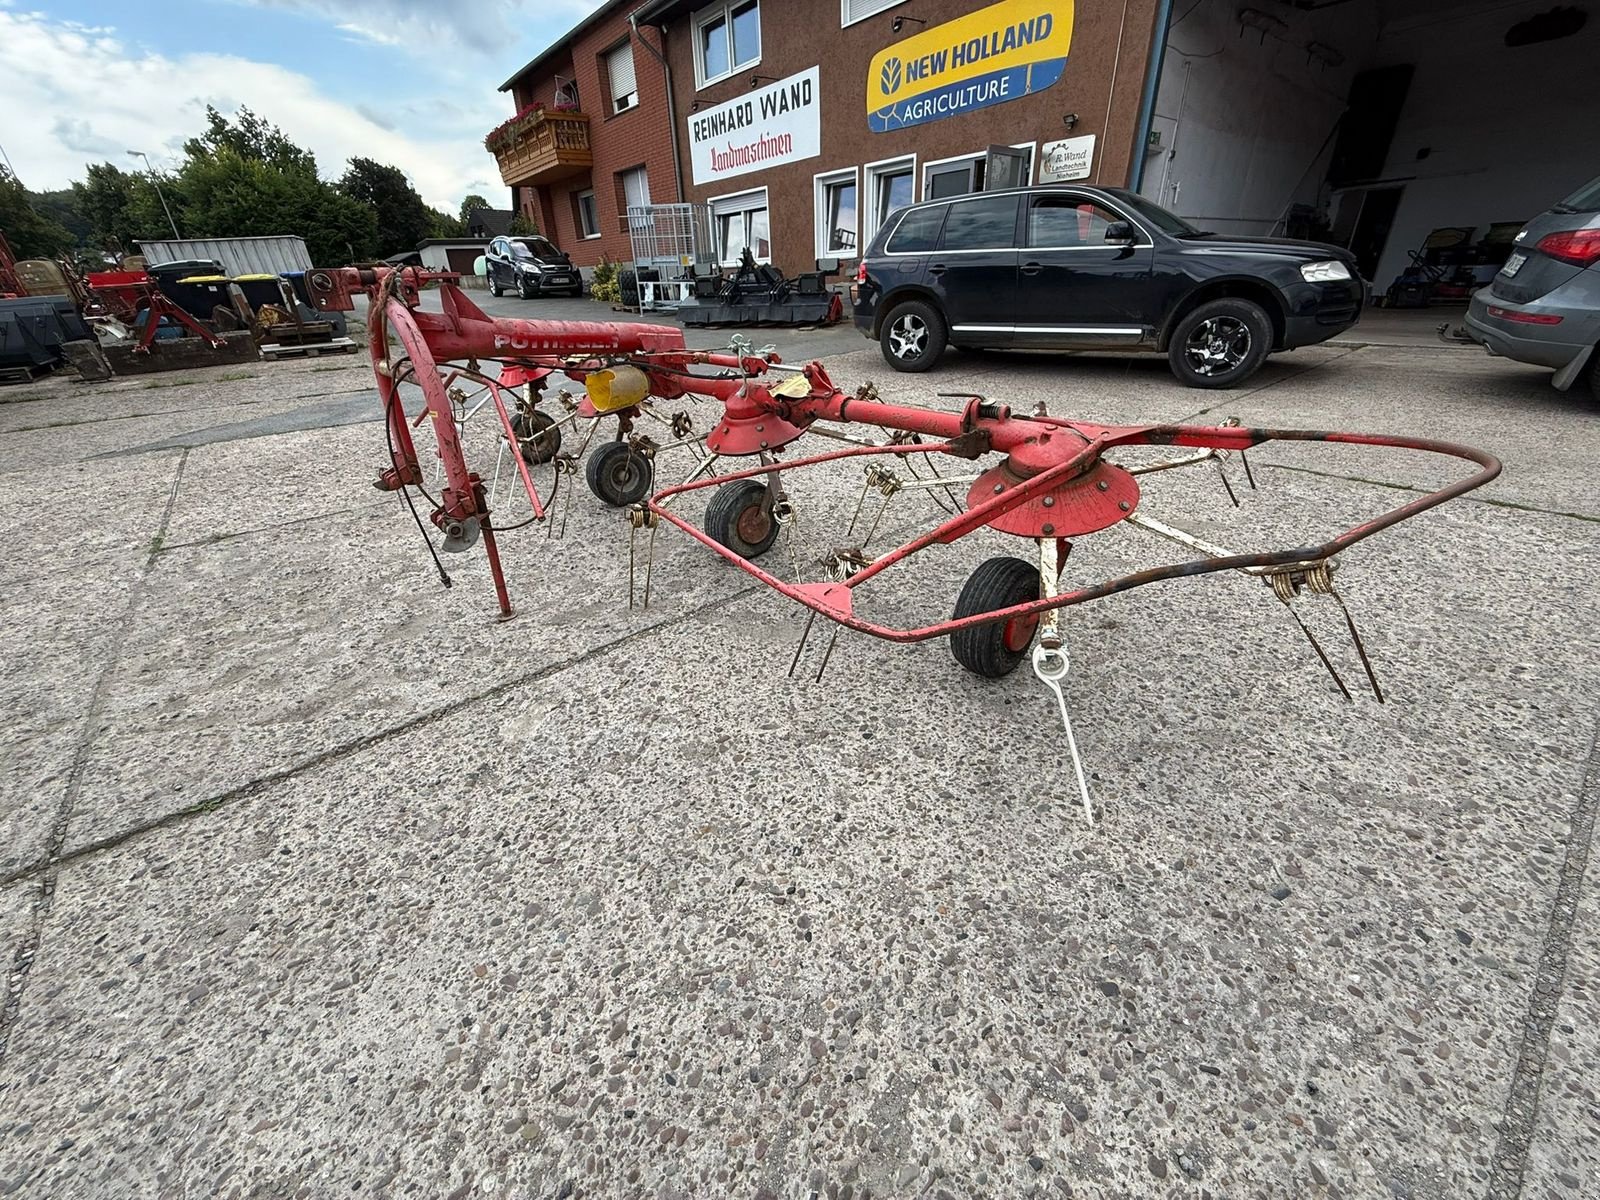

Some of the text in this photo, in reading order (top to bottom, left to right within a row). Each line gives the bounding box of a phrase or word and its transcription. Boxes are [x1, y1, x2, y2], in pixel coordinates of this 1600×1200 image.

[905, 13, 1053, 84] NEW HOLLAND
[693, 78, 812, 142] REINHARD WAND
[903, 75, 1010, 122] AGRICULTURE
[710, 131, 793, 172] Landmaschinen
[1051, 161, 1086, 171] Landtechnik
